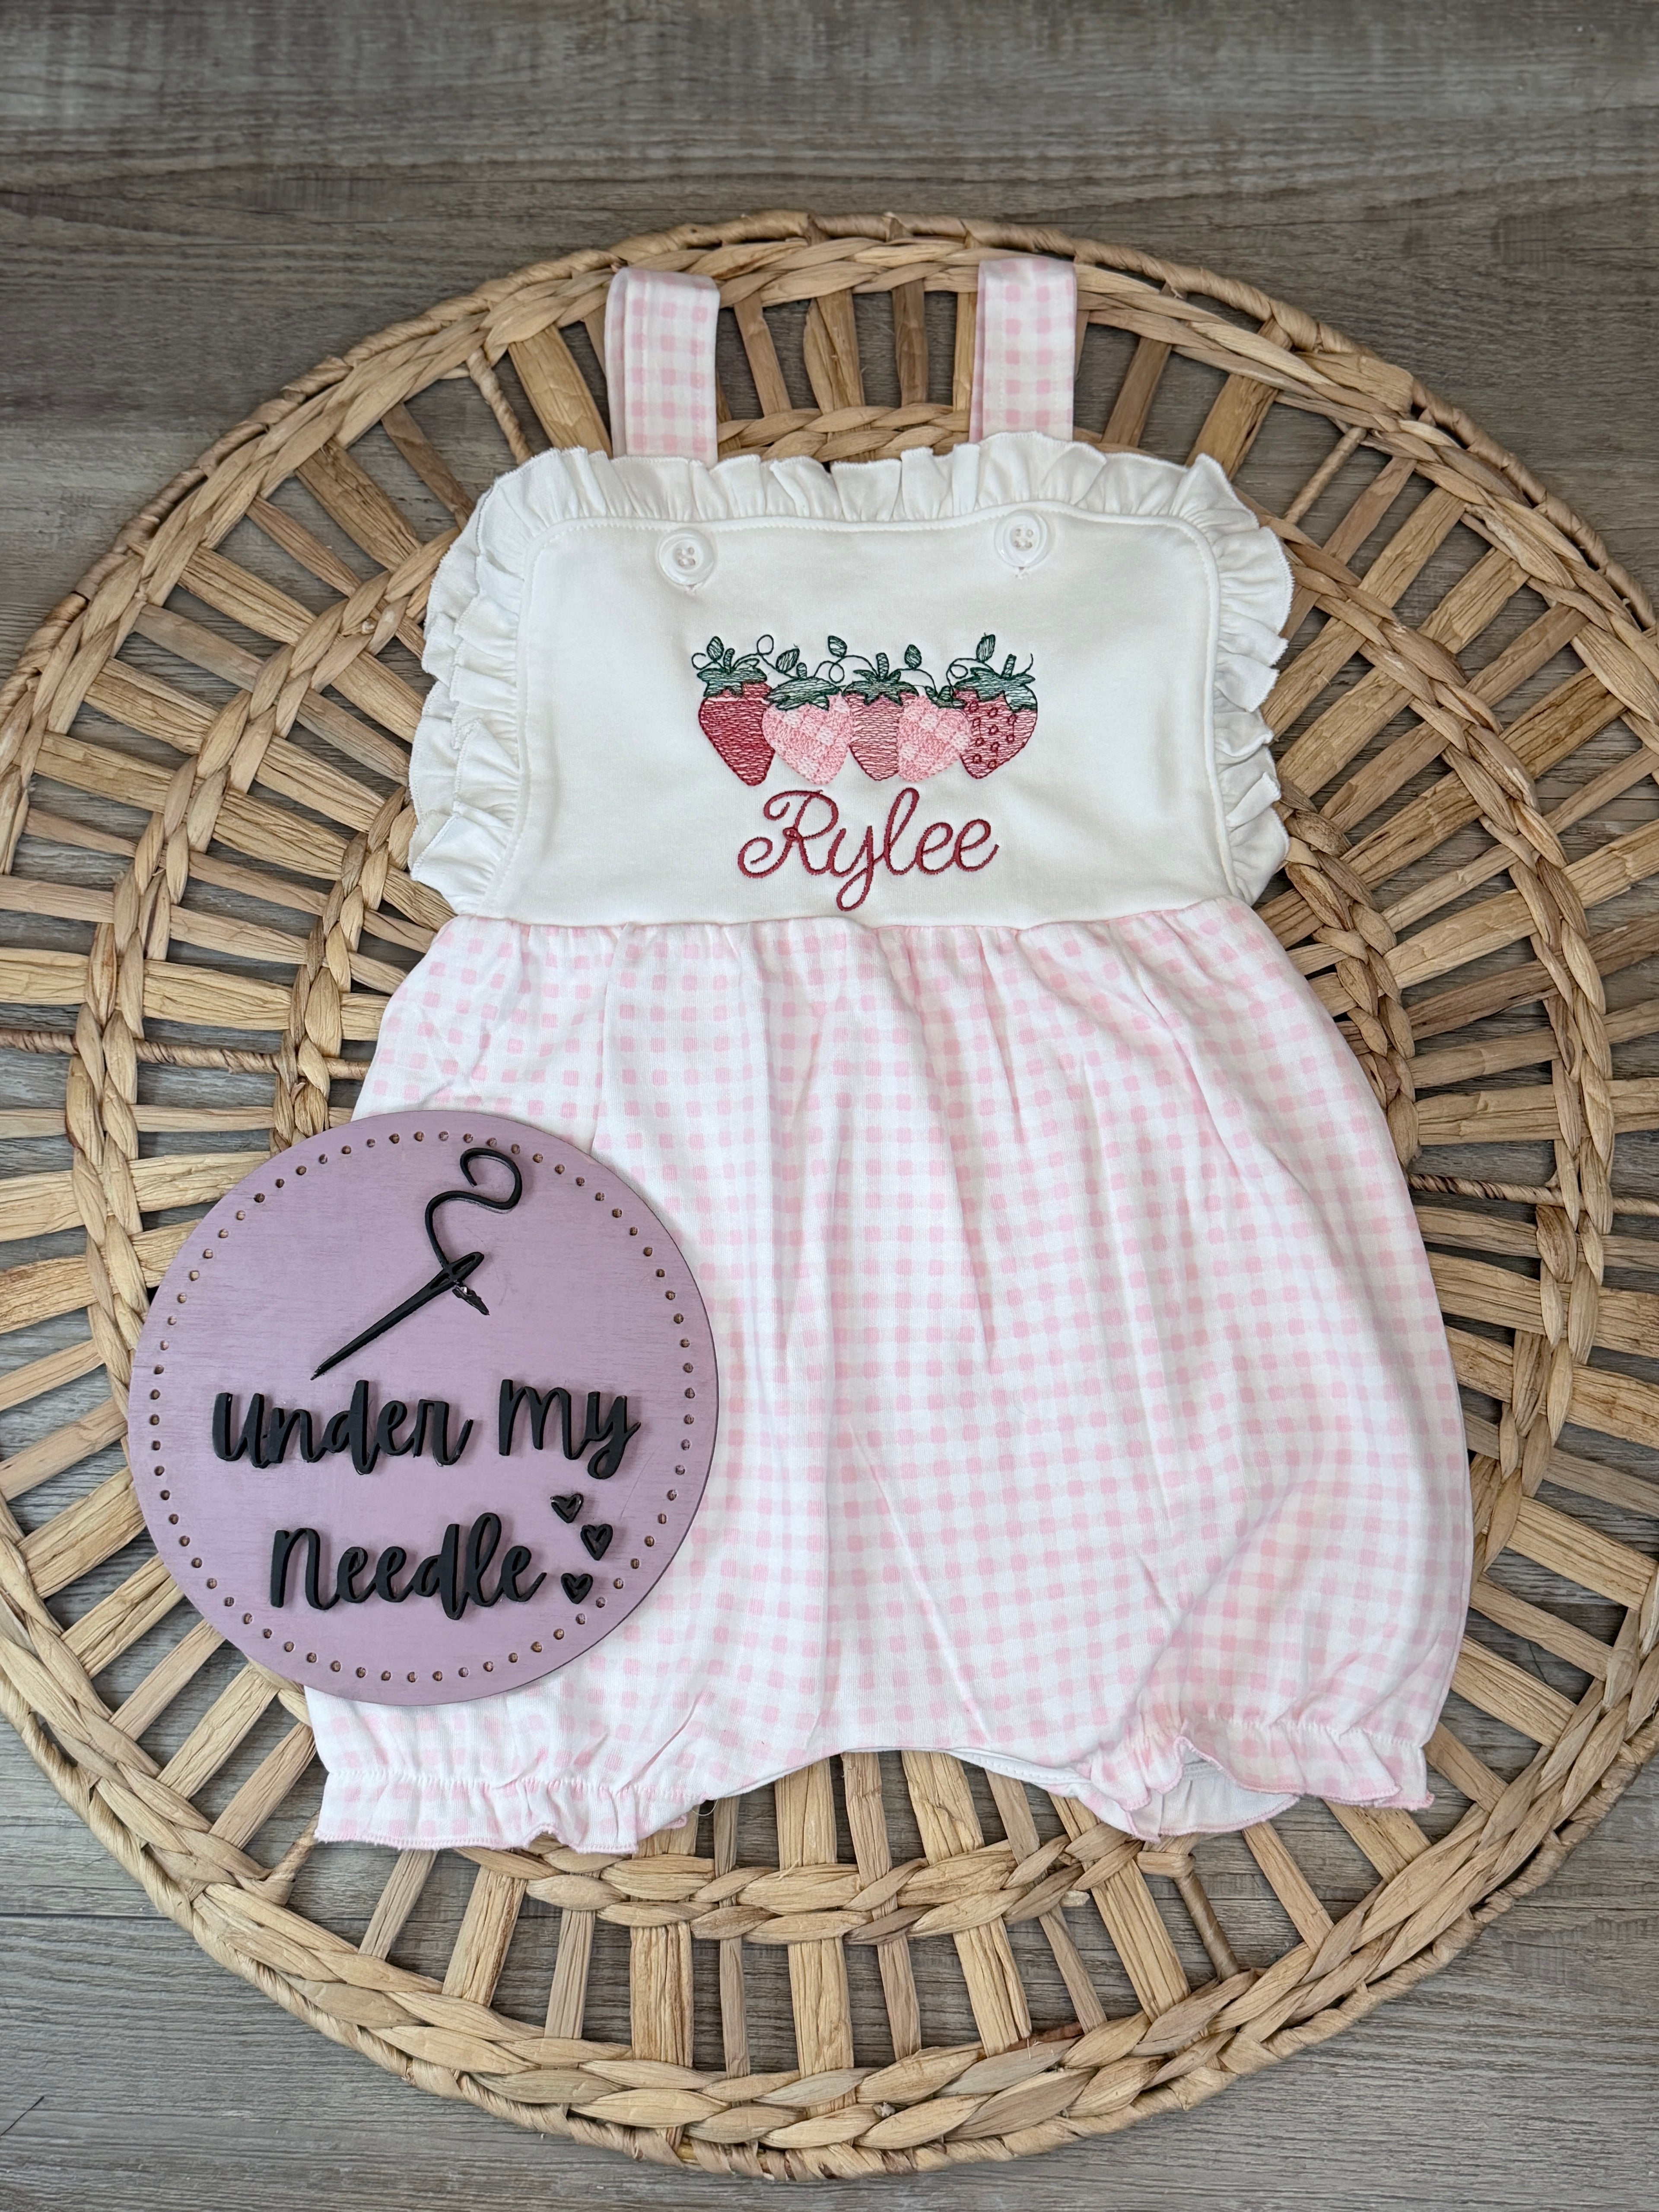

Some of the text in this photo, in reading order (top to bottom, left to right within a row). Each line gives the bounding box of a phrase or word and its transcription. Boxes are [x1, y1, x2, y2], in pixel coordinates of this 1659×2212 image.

[737, 787, 999, 912] Rylee
[498, 1379, 642, 1480] My
[270, 1512, 547, 1621] Needle
